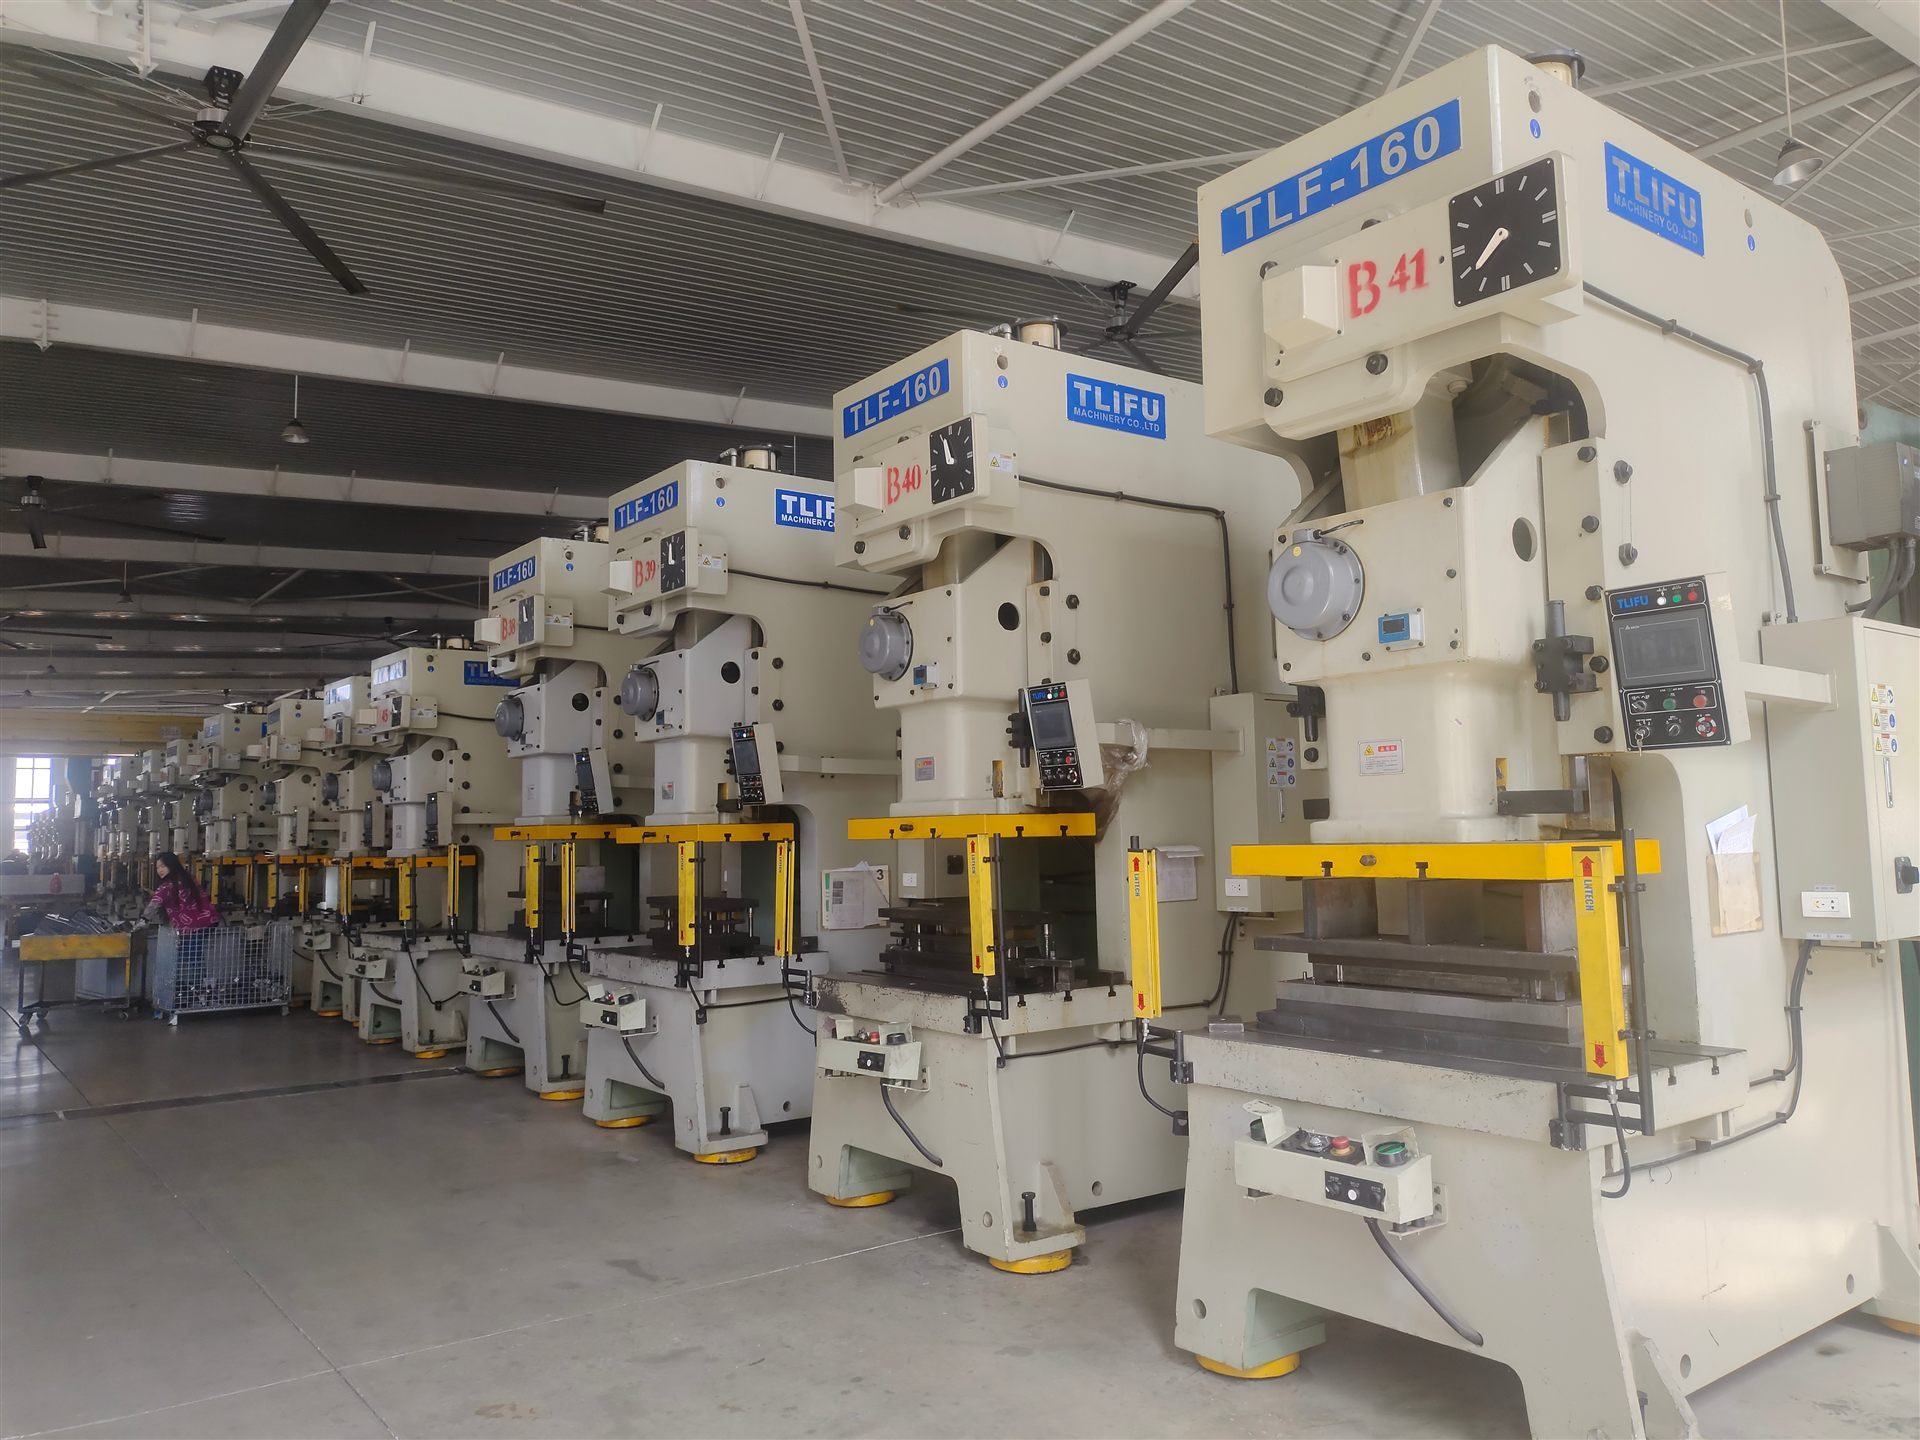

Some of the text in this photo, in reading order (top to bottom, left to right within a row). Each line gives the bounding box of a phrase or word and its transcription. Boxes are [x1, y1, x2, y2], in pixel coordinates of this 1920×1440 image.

[1236, 117, 1440, 239] TLF-160
[1612, 155, 1696, 229] TLIFU
[1614, 193, 1665, 228] MACHINERY
[850, 367, 941, 431] TLF-160
[1073, 381, 1159, 422] TLIFU
[1073, 406, 1125, 425] MACHINERY
[618, 485, 673, 528] TLF-160
[781, 513, 835, 528] MACHINERY C
[496, 560, 533, 590] TLF-160
[1617, 595, 1649, 609] TLIFU
[876, 868, 884, 880] 3
[1583, 879, 1595, 911] LNTECH
